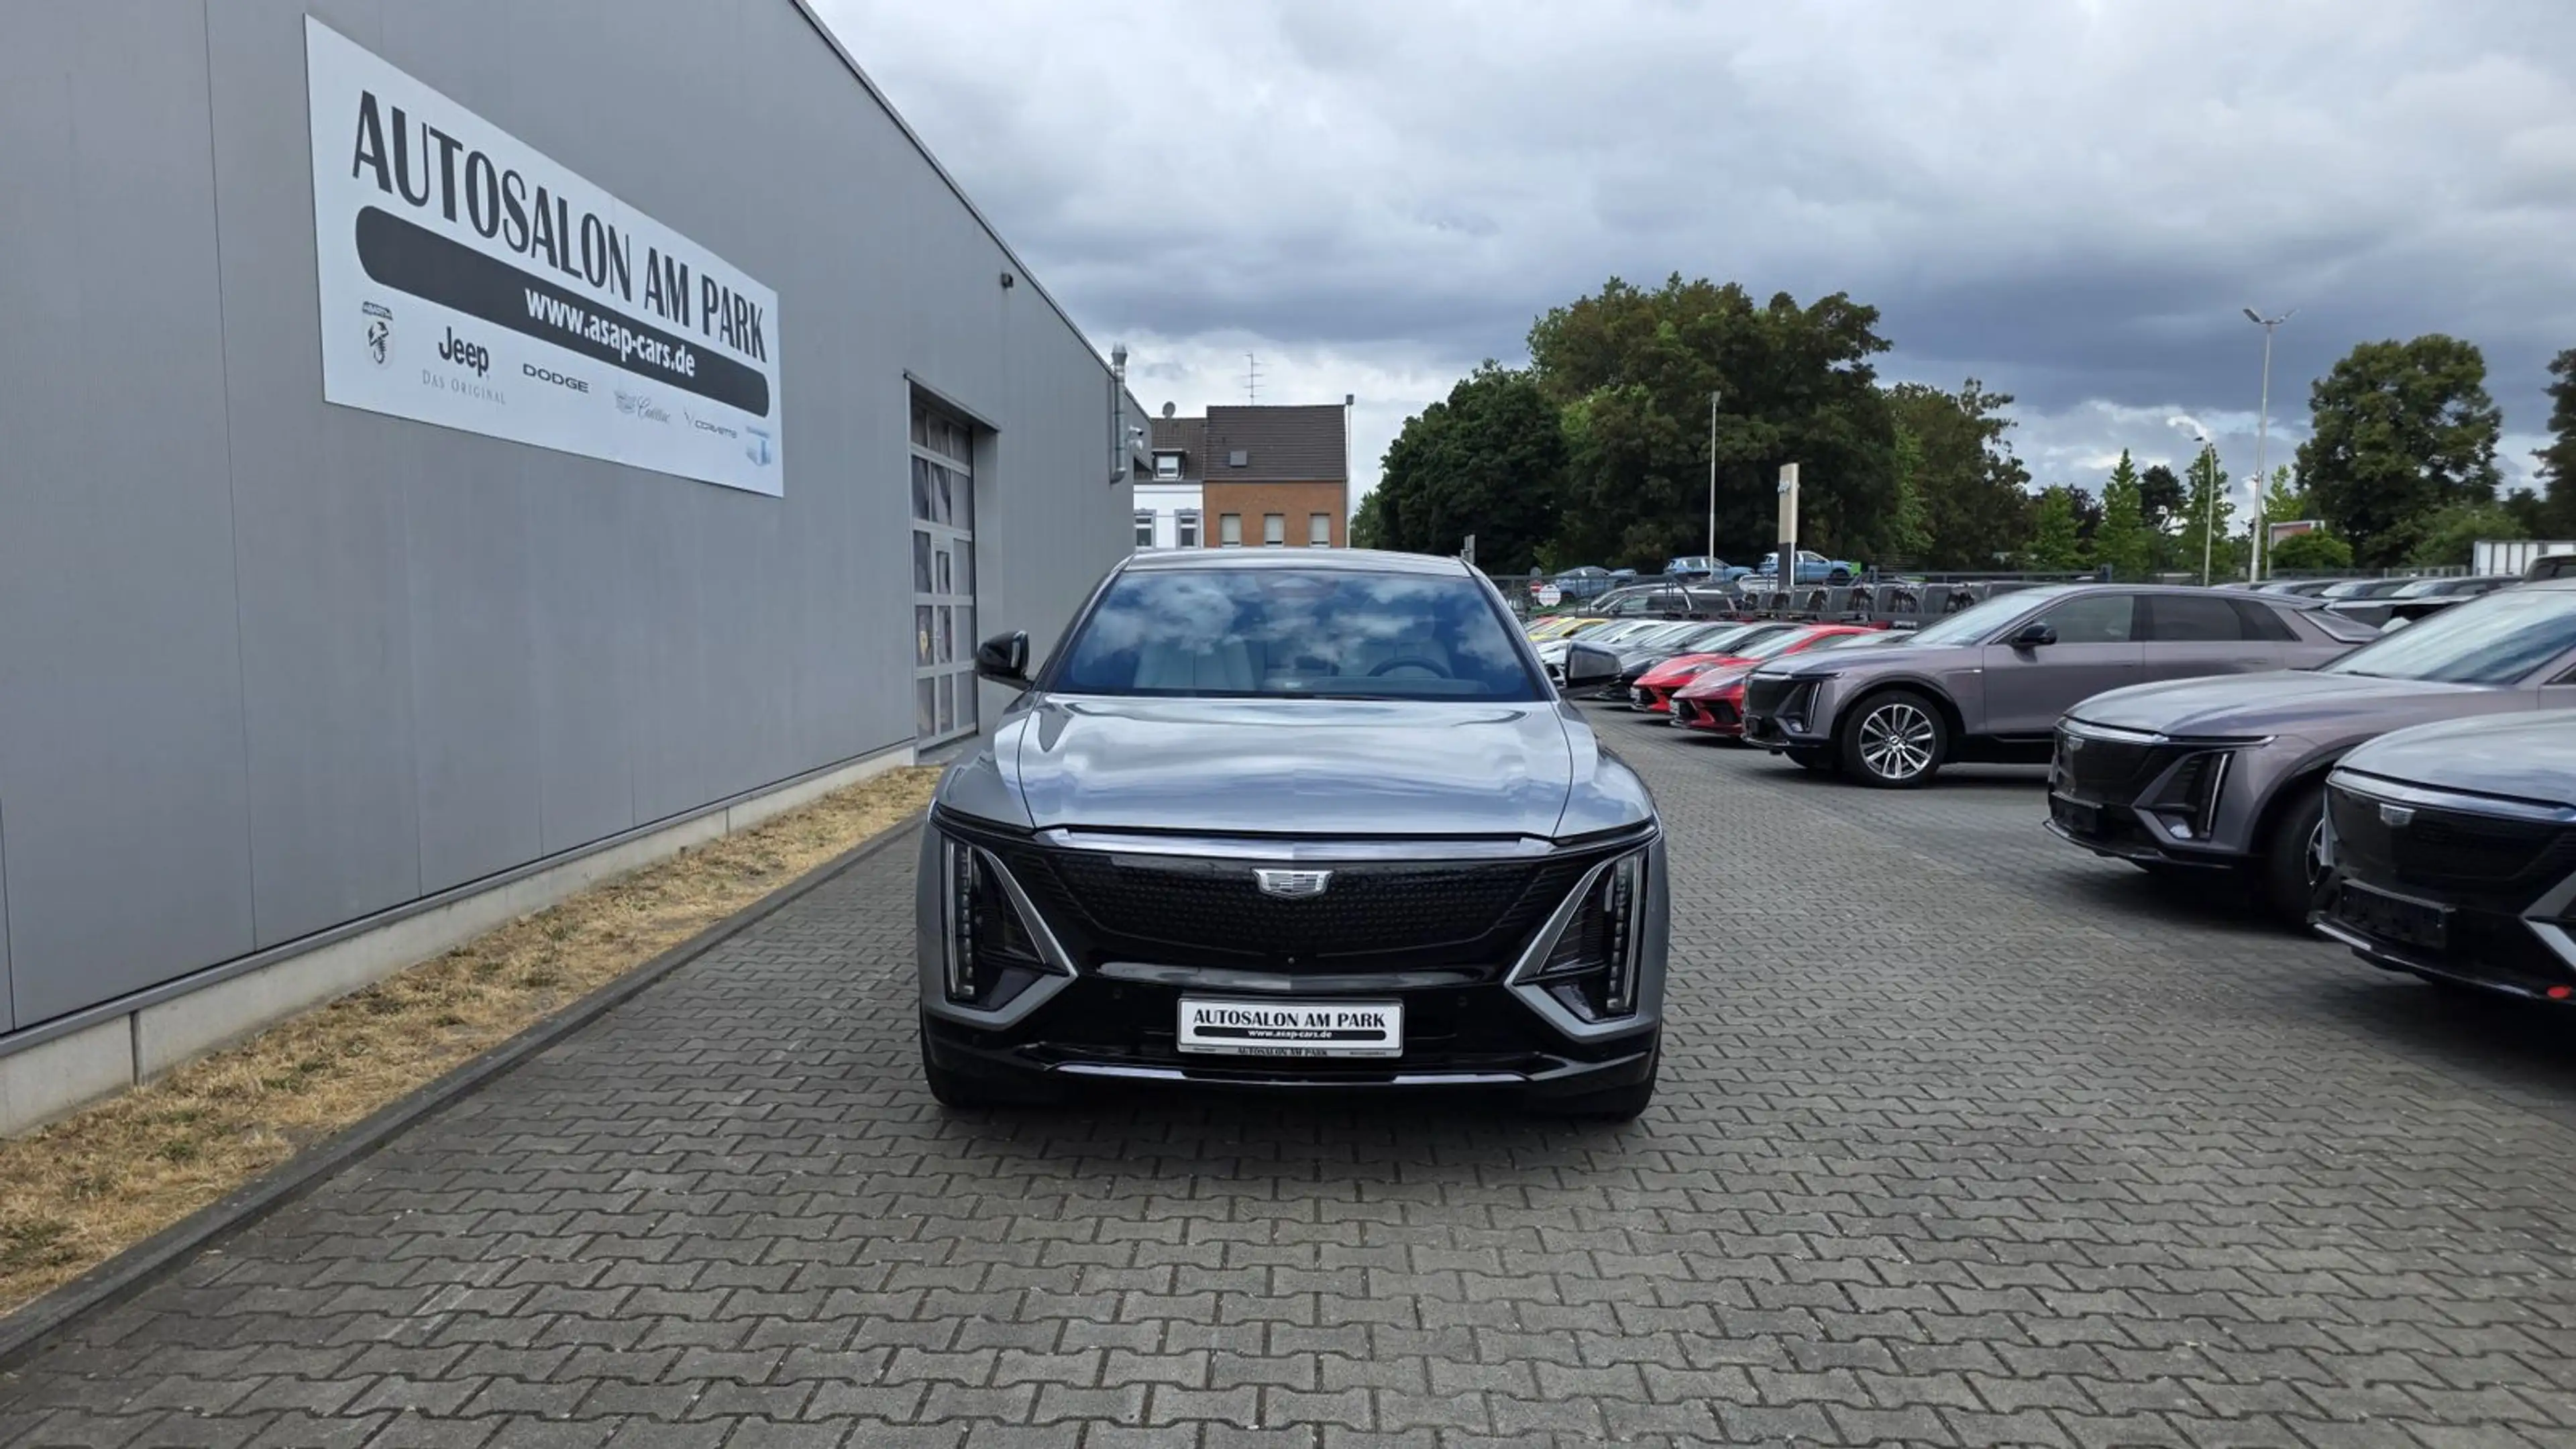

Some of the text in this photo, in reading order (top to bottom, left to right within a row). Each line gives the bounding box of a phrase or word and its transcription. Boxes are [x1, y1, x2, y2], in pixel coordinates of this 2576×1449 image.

[353, 89, 767, 364] AUTOSALON AM PARK
[439, 325, 489, 378] Jeep
[525, 287, 696, 377] www.asap-cars.de
[423, 368, 506, 405] DAS ORIGINAL
[523, 363, 589, 394] DODGE
[1193, 1009, 1385, 1028] AUTOSALON AM PARK
